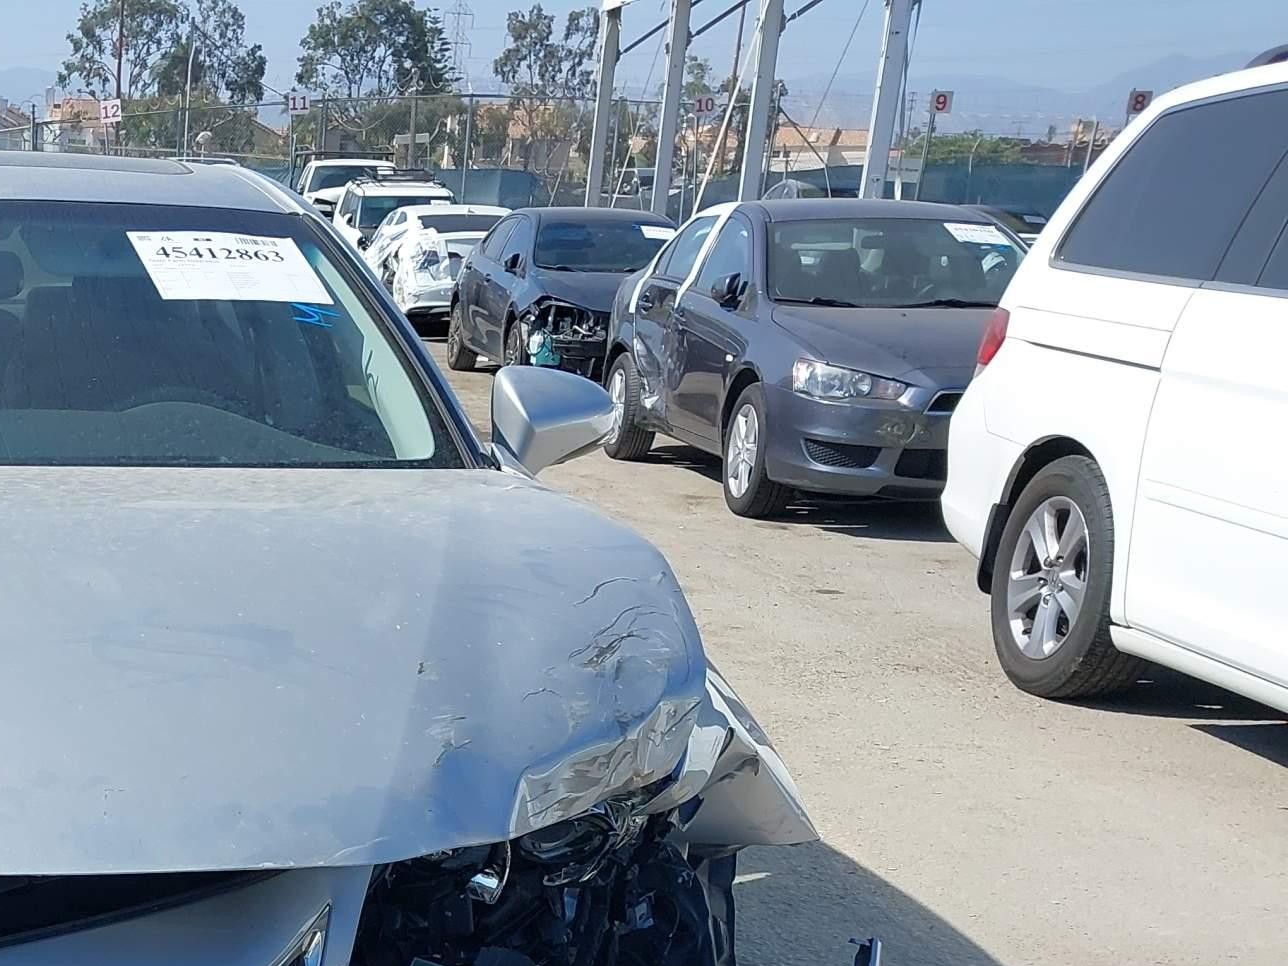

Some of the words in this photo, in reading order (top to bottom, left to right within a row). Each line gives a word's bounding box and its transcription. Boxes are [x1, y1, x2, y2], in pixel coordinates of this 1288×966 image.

[290, 95, 309, 111] 11
[696, 97, 714, 112] 10
[935, 94, 948, 111] 9
[1132, 94, 1146, 112] 8
[102, 104, 121, 119] 12
[155, 246, 285, 262] 45412863
